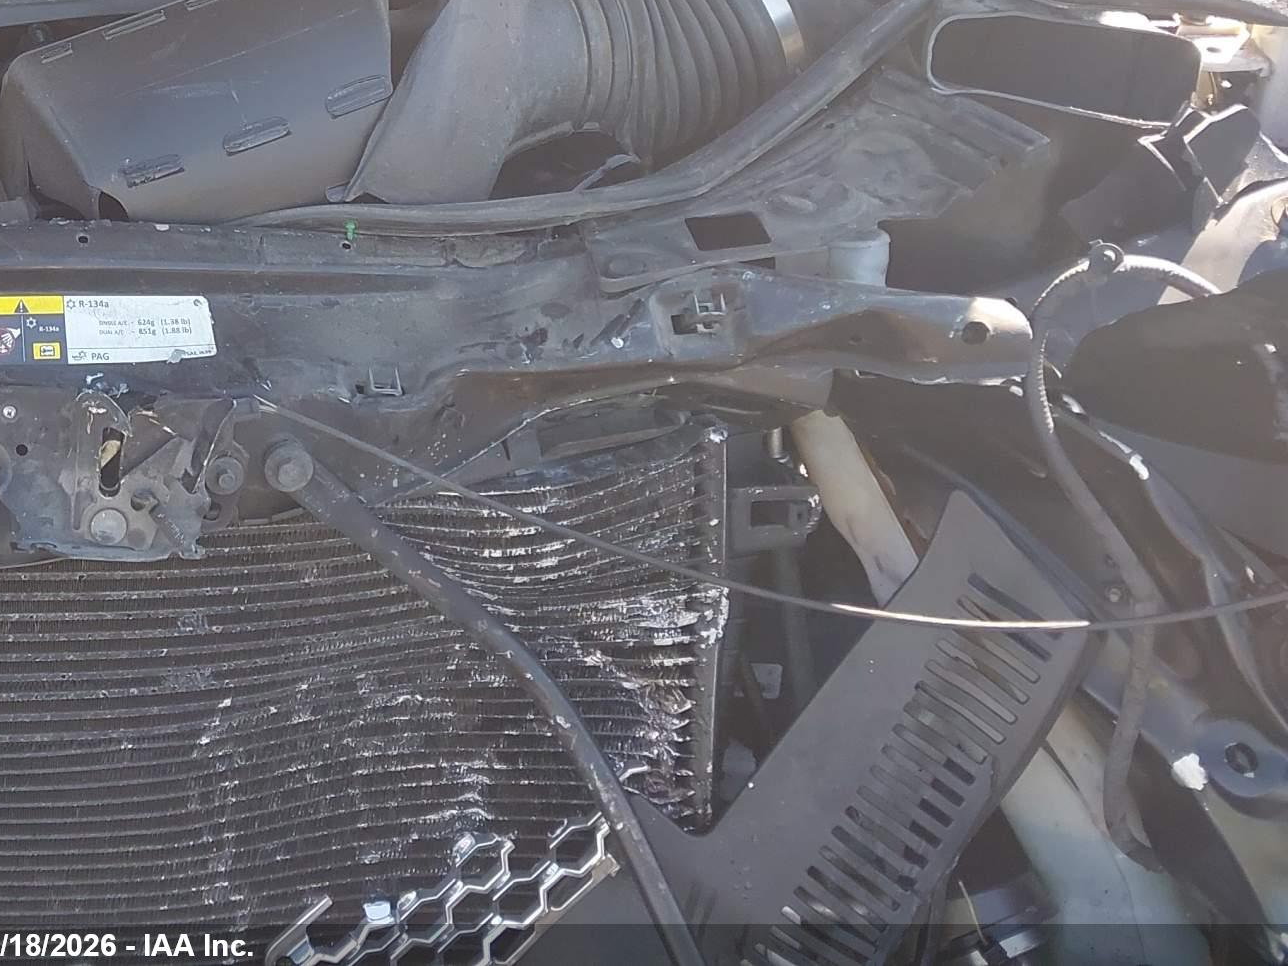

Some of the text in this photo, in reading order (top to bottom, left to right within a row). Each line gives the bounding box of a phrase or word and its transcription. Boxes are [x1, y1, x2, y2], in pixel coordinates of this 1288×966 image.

[78, 299, 110, 308] R-134a
[137, 319, 155, 327] 624g
[160, 318, 179, 326] (1.38
[181, 318, 191, 326] lb)
[138, 327, 156, 336] 851g
[162, 327, 181, 335] (1.88
[182, 326, 192, 335] lb)
[91, 352, 110, 361] PAG
